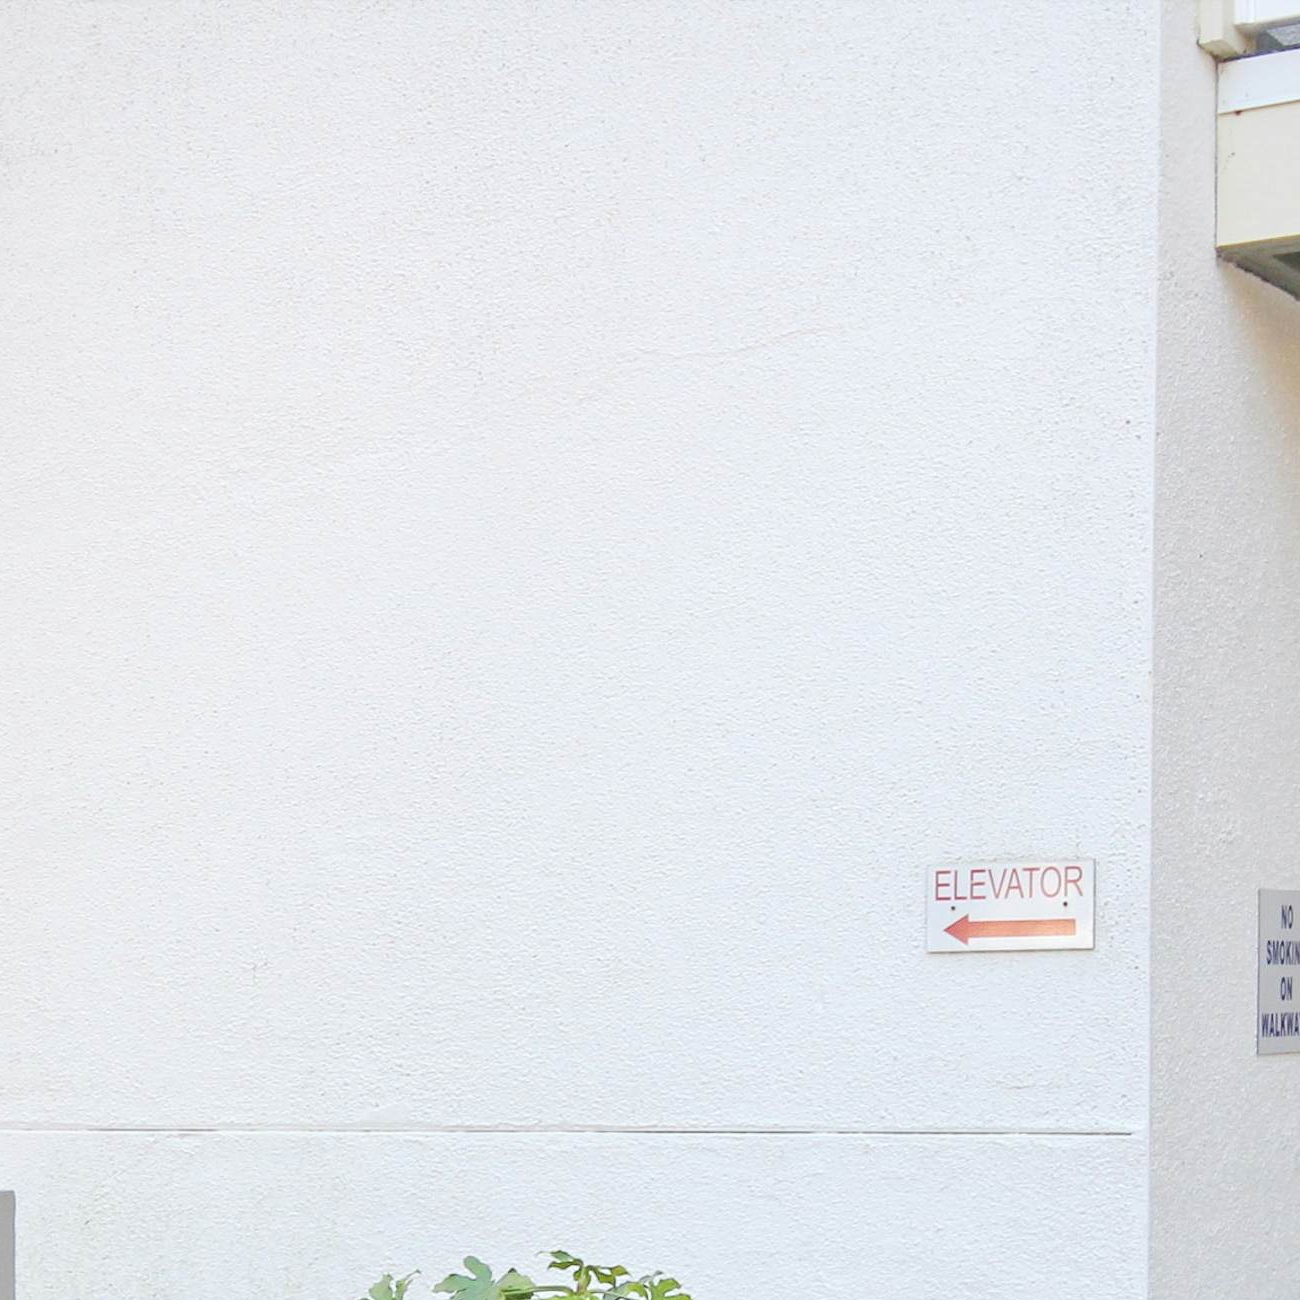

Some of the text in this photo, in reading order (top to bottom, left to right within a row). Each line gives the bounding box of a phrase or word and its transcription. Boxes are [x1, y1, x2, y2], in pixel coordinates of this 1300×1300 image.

[935, 866, 1084, 900] ELEVATOR
[1281, 905, 1293, 929] NO
[1280, 977, 1292, 1001] ON
